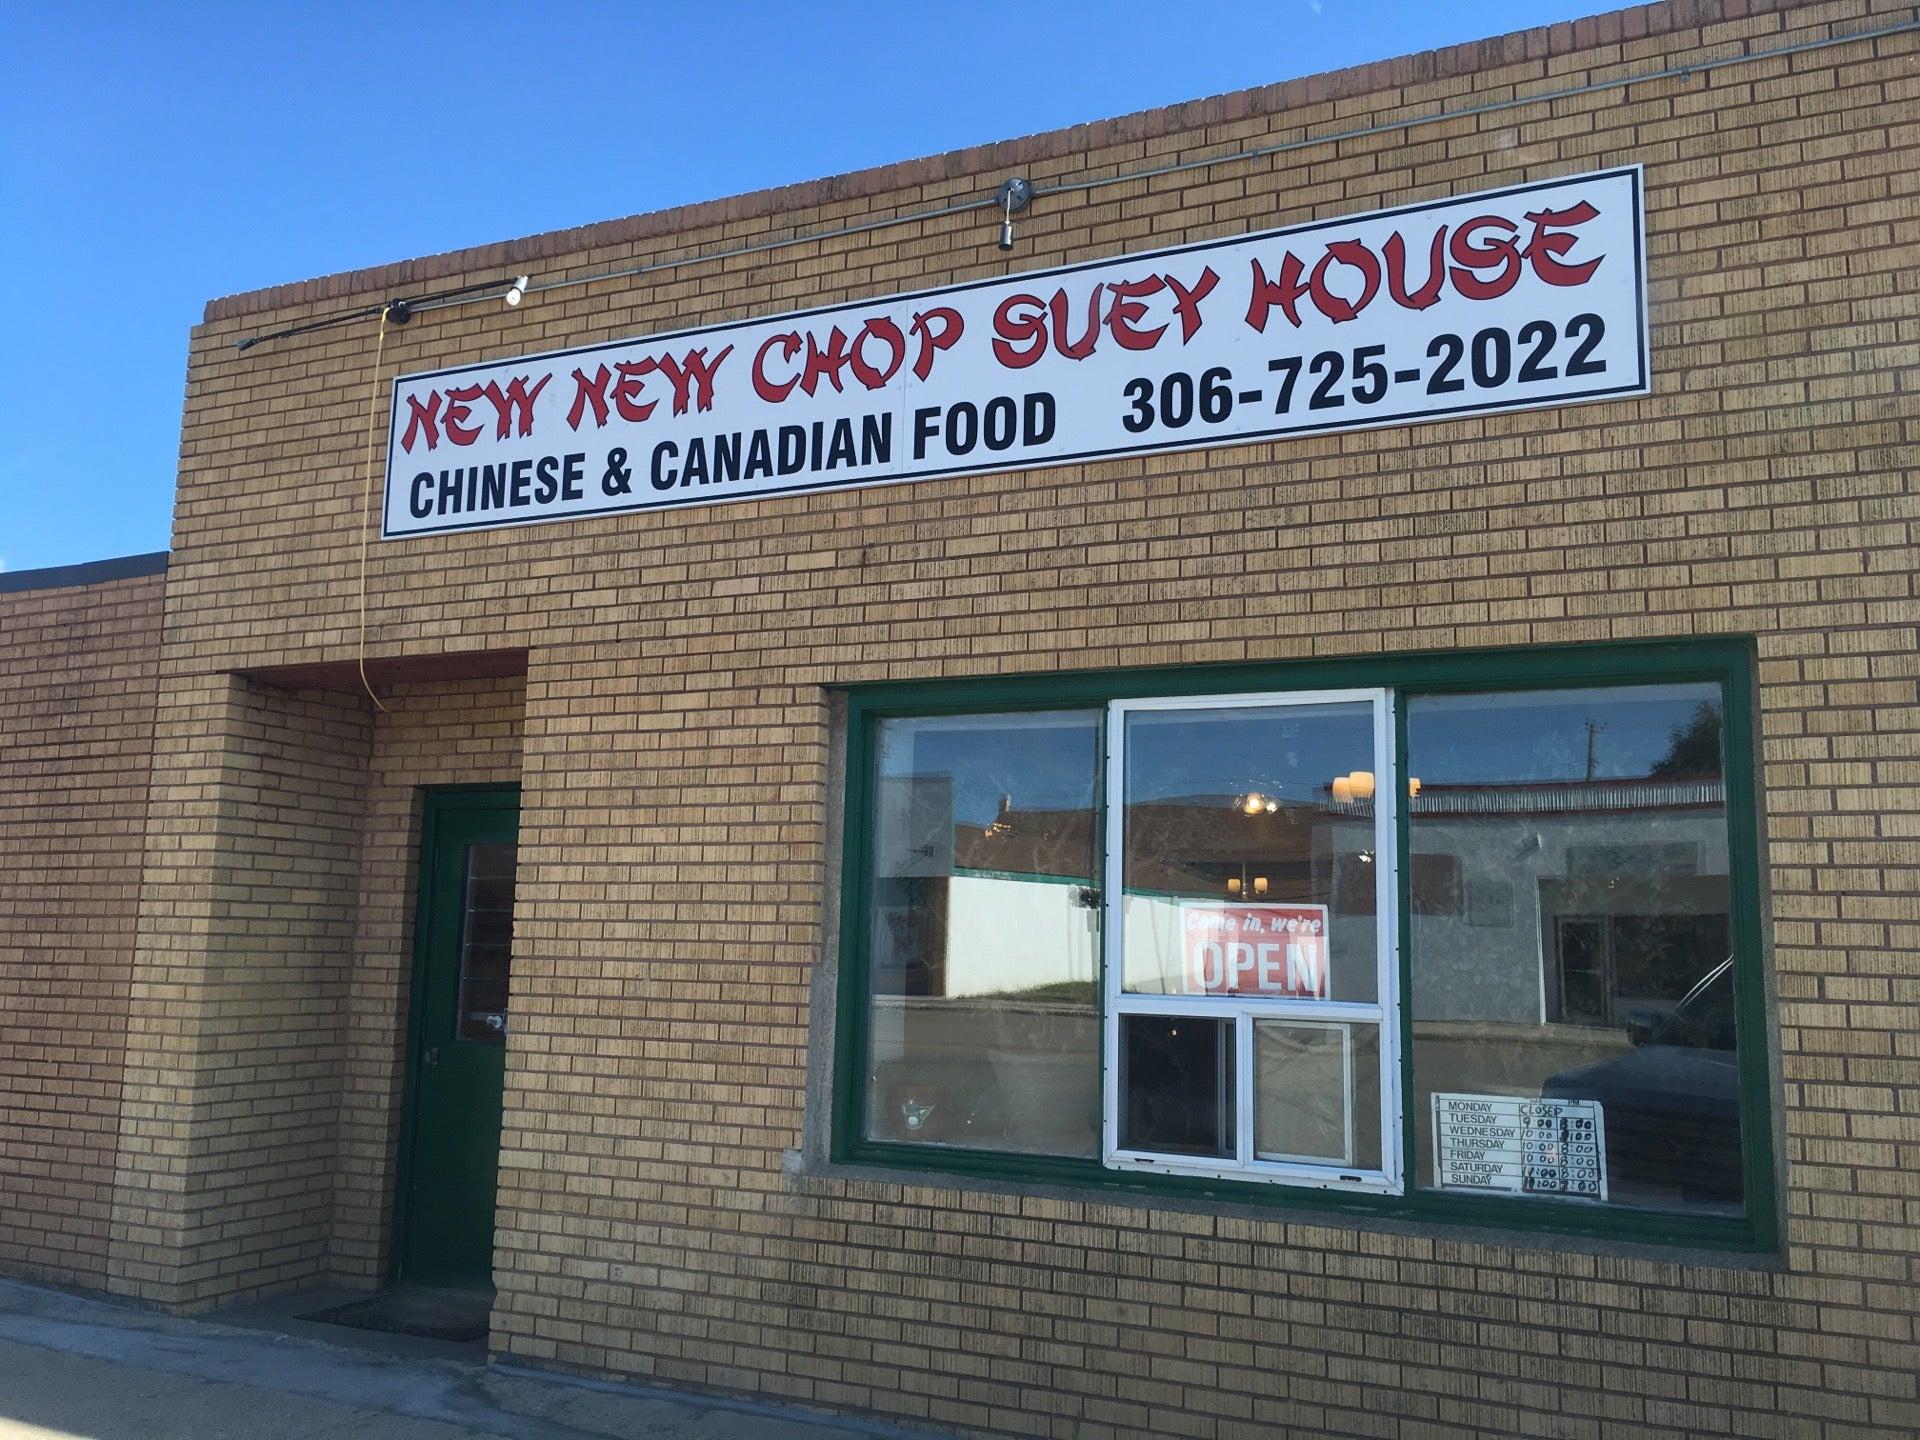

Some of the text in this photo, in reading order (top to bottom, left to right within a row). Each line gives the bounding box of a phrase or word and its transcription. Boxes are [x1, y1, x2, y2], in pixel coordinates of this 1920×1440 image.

[401, 200, 1607, 455] NEW NEW CHOP SUEY HOUSE
[410, 312, 1608, 519] CHINESE & CANADIAN FOOD 306-725-2022
[1186, 912, 1322, 934] Come in, we're
[1193, 941, 1318, 992] OPEN
[1448, 1101, 1563, 1117] MONDAY CLOSED
[1449, 1113, 1497, 1124] TUESDAY
[1449, 1125, 1515, 1138] WEDNESDAY
[1450, 1137, 1505, 1149] THURSDAY
[1561, 1143, 1593, 1155] 8:00
[1450, 1149, 1485, 1160] FRIDAY
[1560, 1155, 1595, 1166] 8:00
[1450, 1161, 1503, 1173] SATURDAY
[1561, 1167, 1595, 1178] 8:00
[1451, 1173, 1492, 1185] SUNDAY
